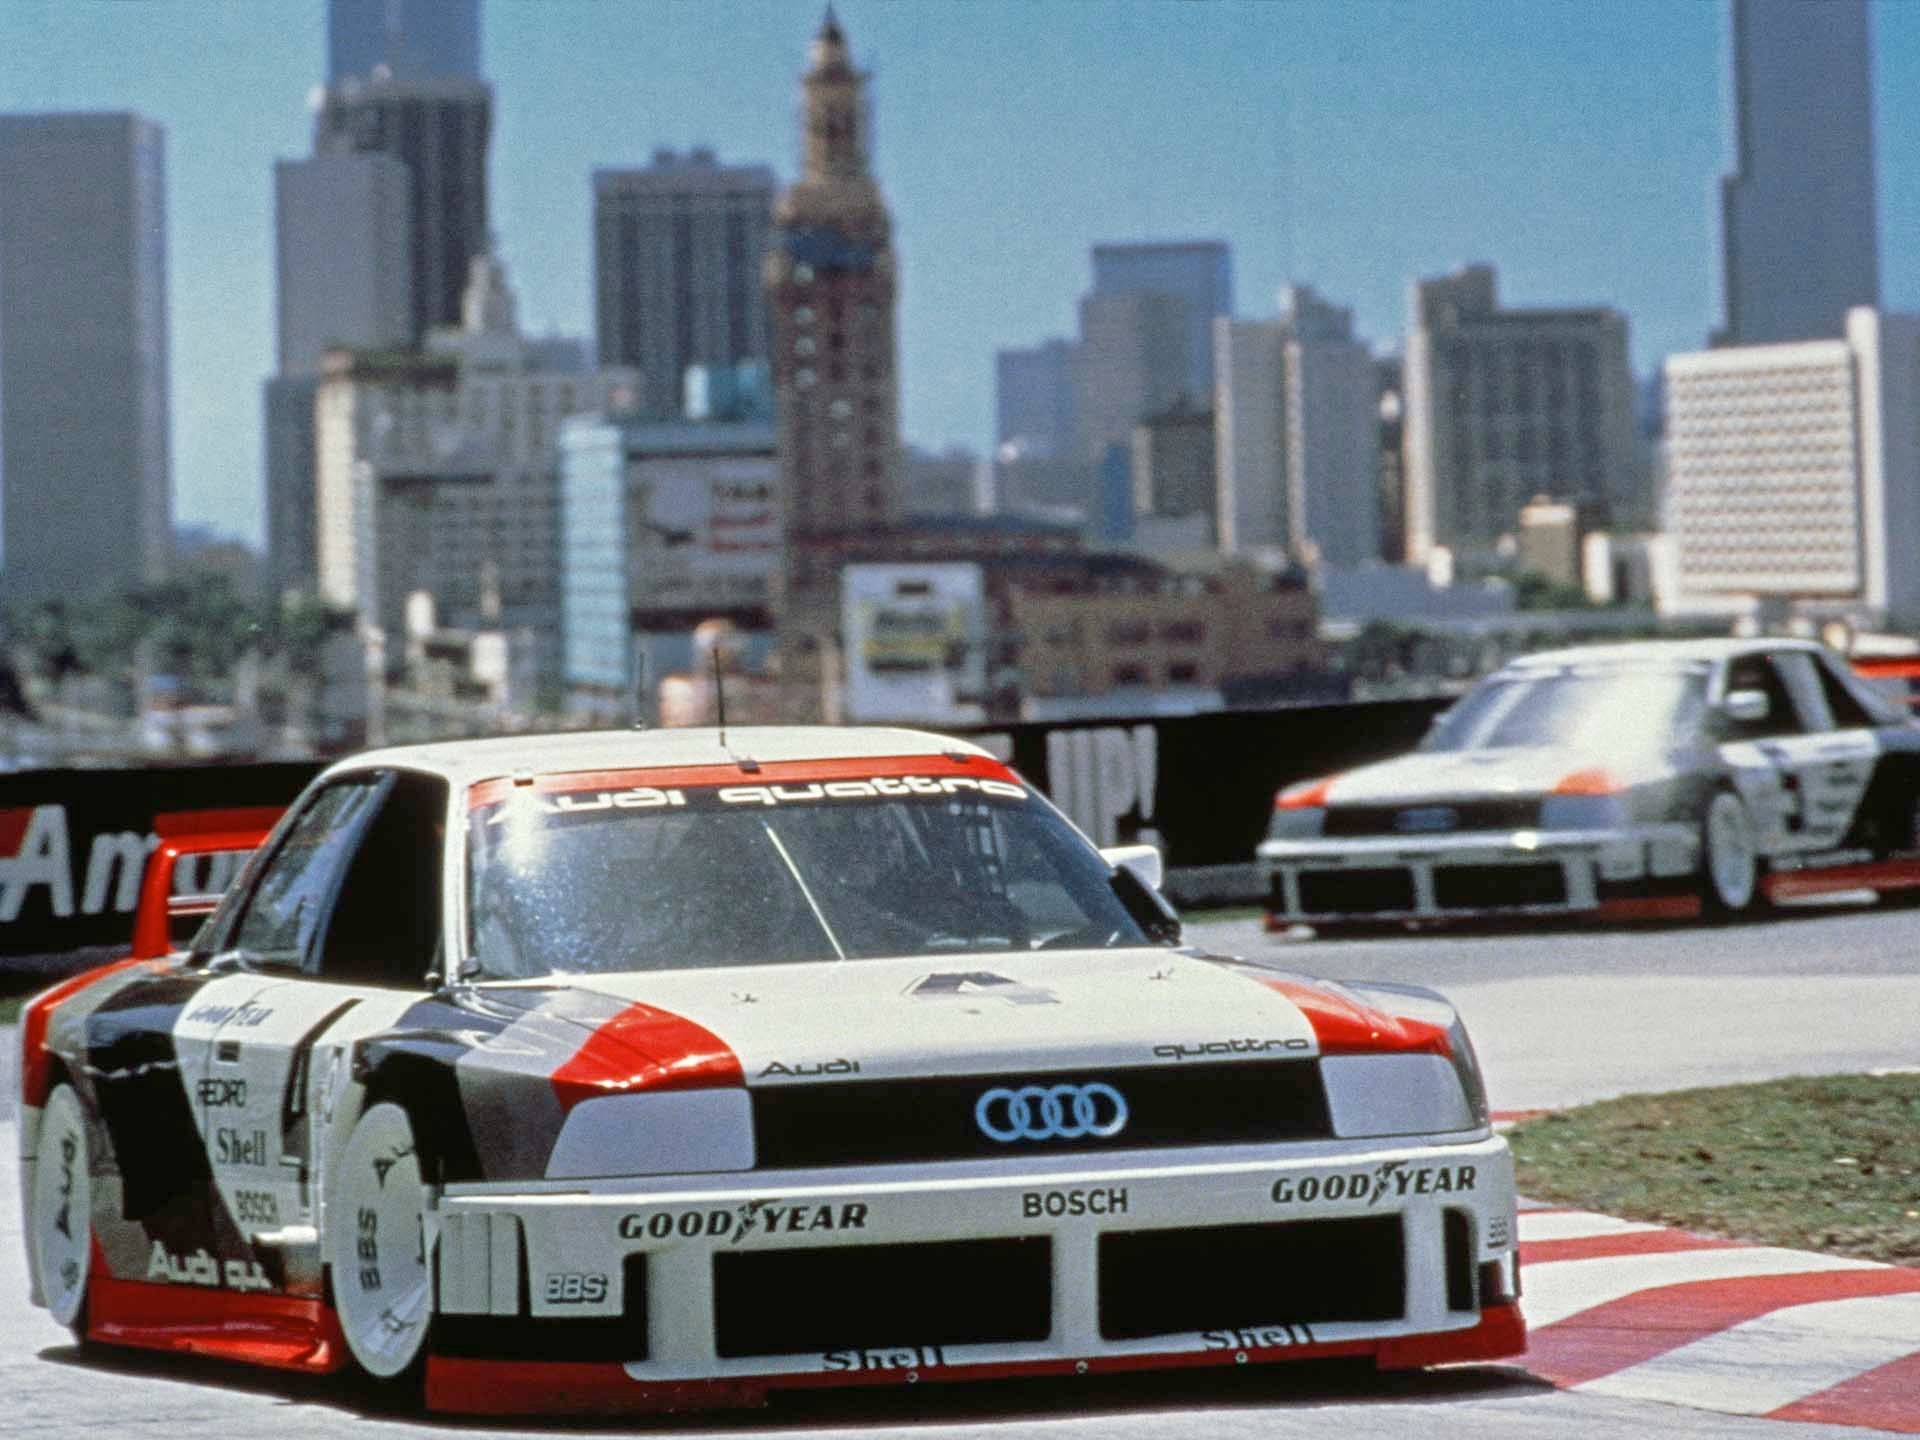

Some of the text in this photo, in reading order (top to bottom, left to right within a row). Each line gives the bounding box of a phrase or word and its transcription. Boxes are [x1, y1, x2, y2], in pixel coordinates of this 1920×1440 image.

[718, 776, 1028, 804] quattro
[1152, 1038, 1310, 1060] quattro
[757, 1058, 860, 1078] Audi
[216, 1128, 266, 1167] Shell
[1023, 1188, 1127, 1218] BOSCH
[147, 1240, 219, 1286] Audi
[357, 1206, 382, 1291] BBS
[545, 1272, 608, 1304] BBS
[1201, 1321, 1313, 1350] Shell
[823, 1345, 943, 1372] Shell
